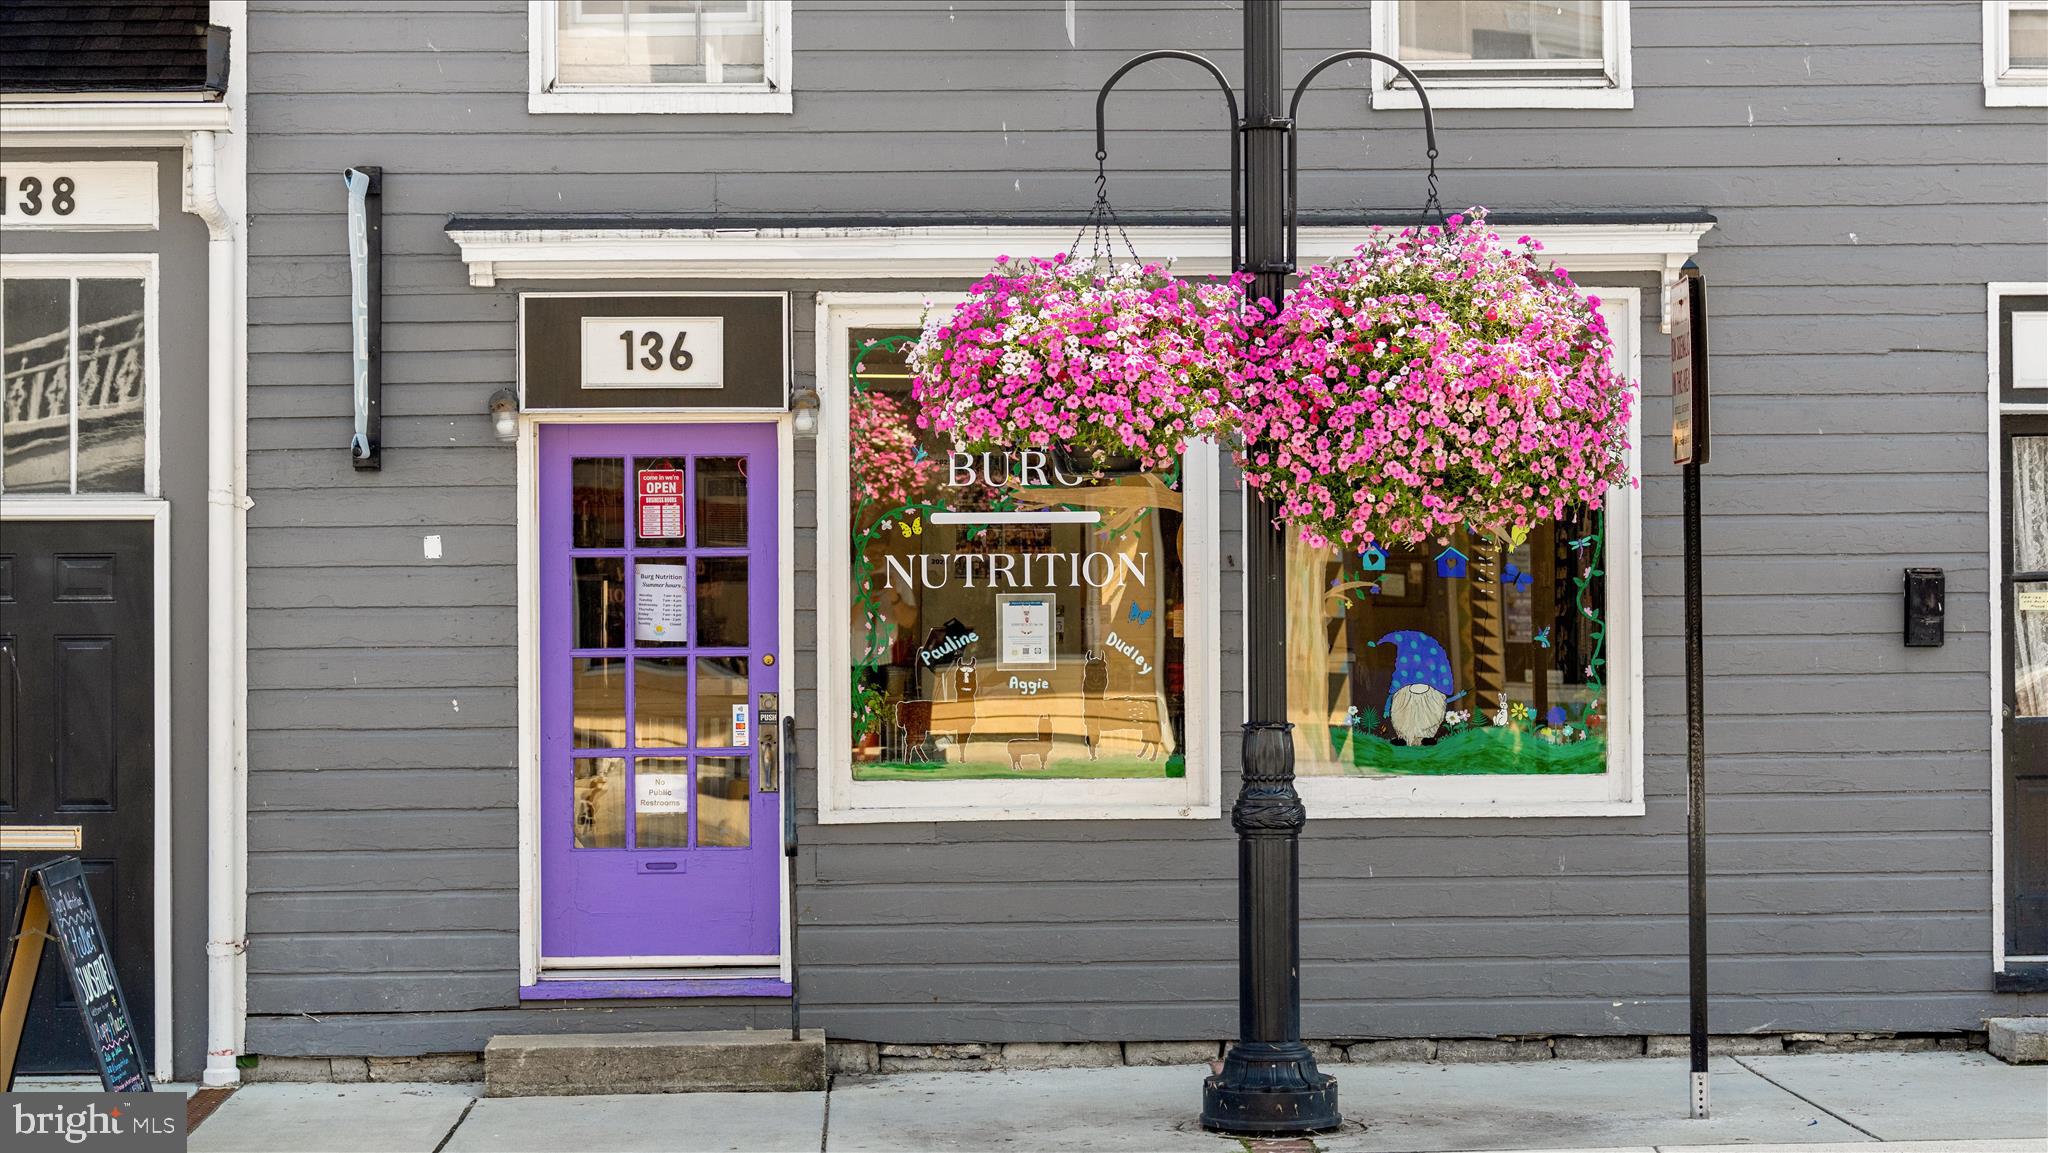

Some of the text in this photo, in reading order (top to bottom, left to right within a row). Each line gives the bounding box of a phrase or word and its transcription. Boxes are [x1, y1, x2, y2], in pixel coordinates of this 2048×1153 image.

[619, 330, 693, 371] 136
[646, 481, 677, 494] OPEN
[883, 551, 1149, 590] NUTRITION
[920, 631, 979, 666] Pauline
[1105, 631, 1153, 675] Dudley
[1009, 675, 1049, 695] Aggie
[655, 778, 666, 786] No
[640, 799, 681, 807] Restrooms
